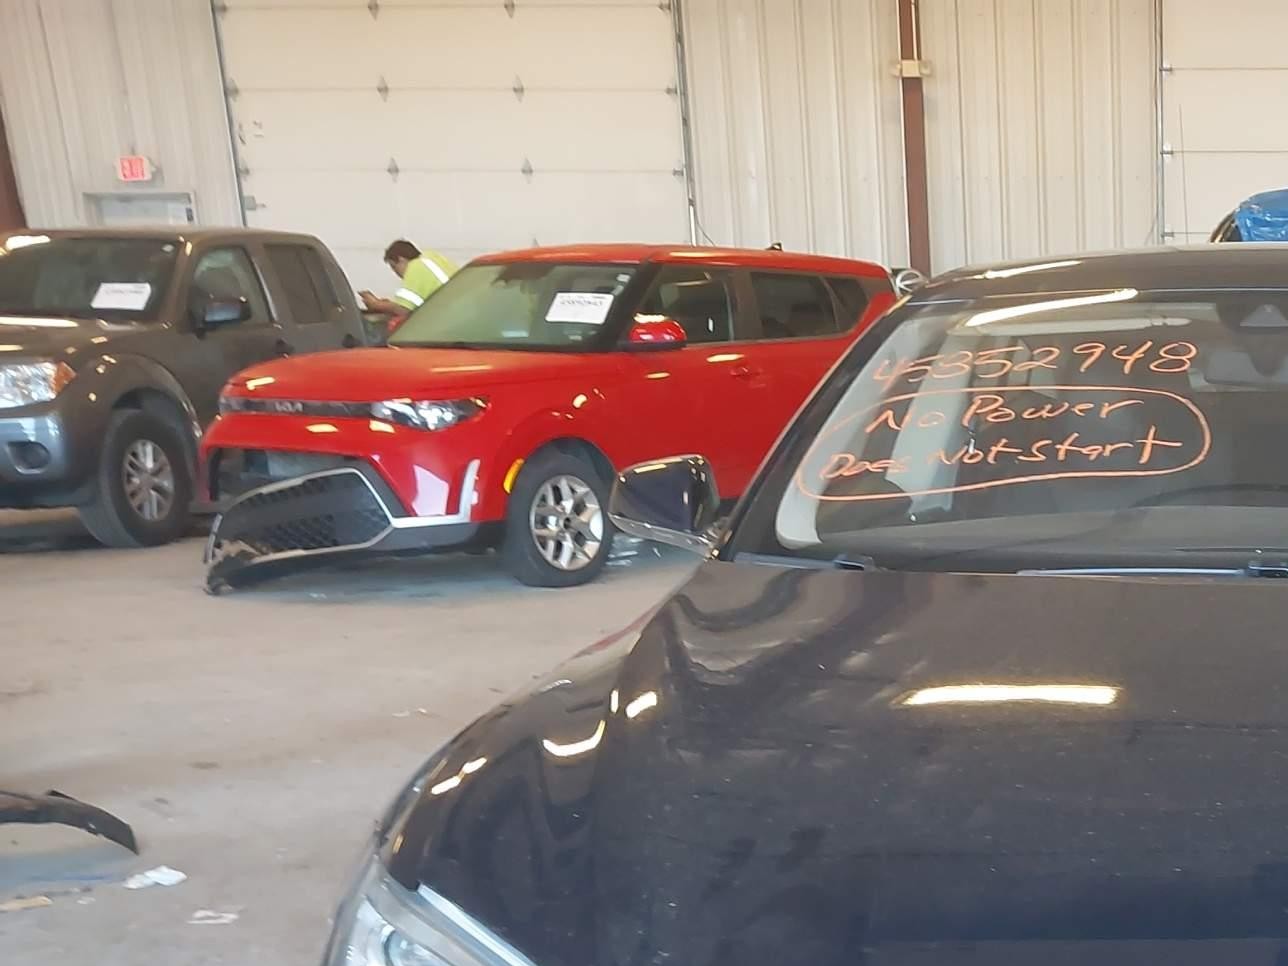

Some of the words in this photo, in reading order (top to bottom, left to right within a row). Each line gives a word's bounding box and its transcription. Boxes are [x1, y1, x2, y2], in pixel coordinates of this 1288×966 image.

[865, 408, 946, 433] No
[961, 394, 1144, 427] Power
[927, 436, 1021, 465] Not
[1016, 425, 1183, 464] Start
